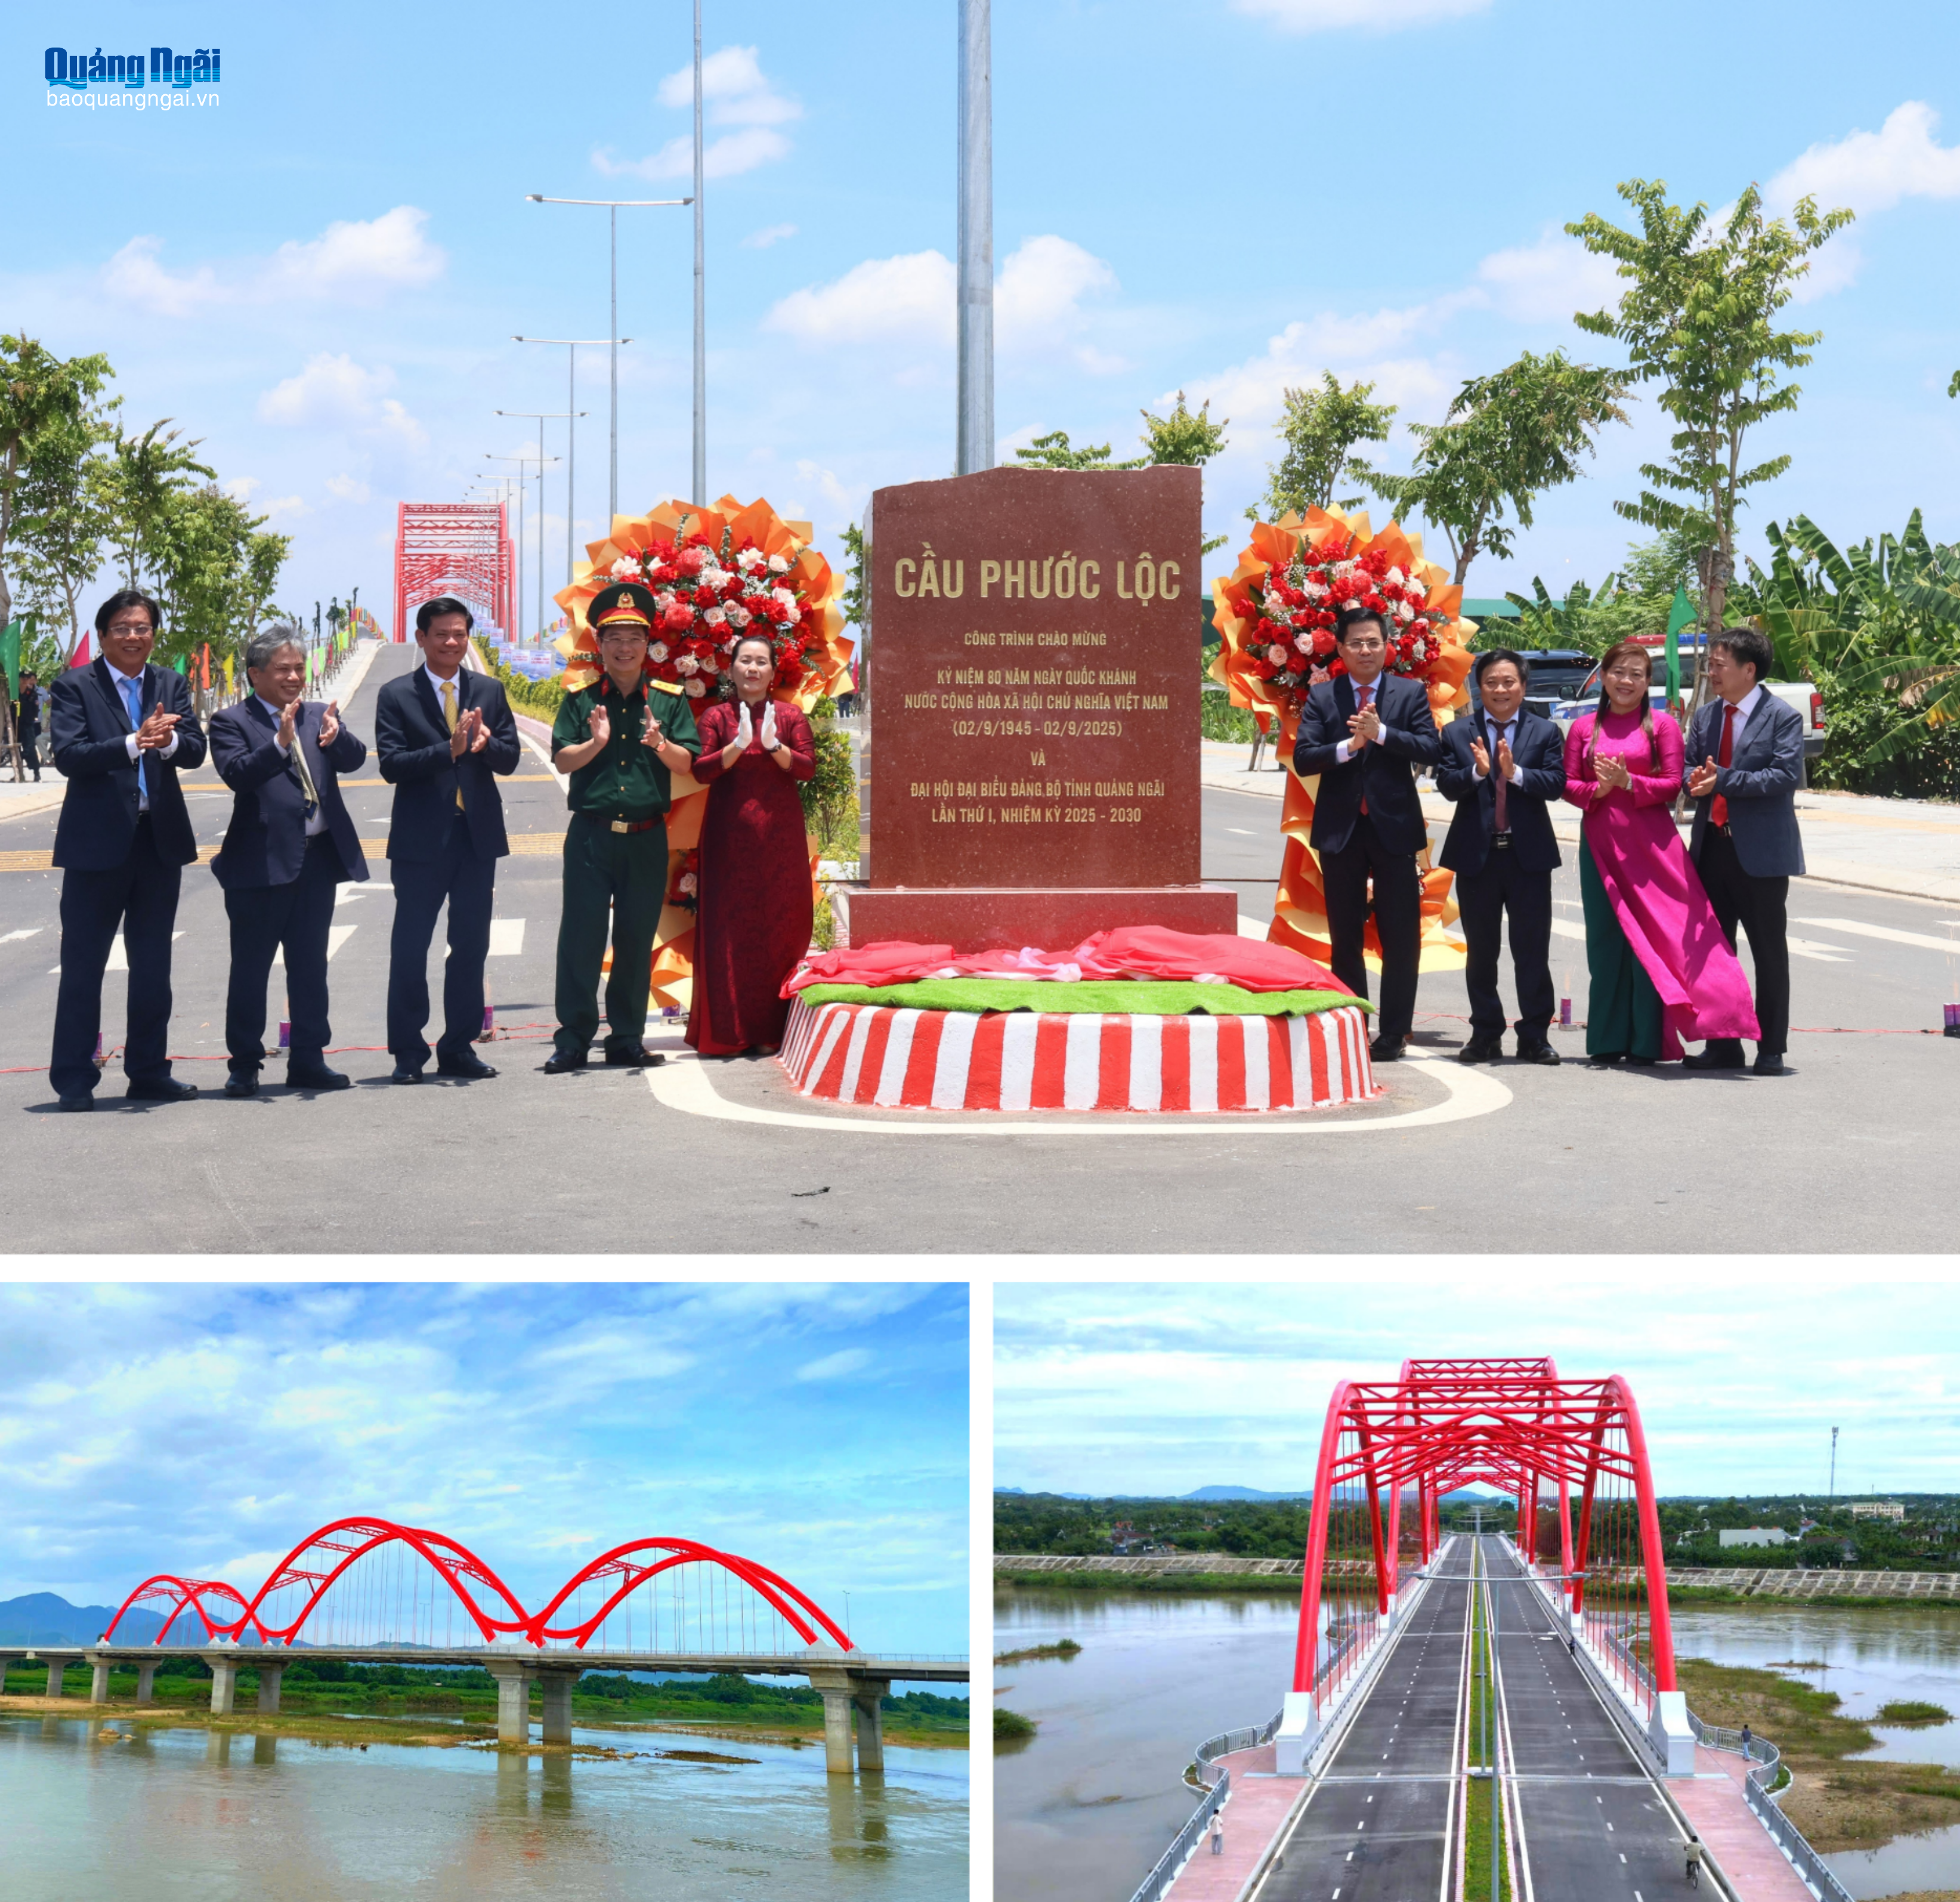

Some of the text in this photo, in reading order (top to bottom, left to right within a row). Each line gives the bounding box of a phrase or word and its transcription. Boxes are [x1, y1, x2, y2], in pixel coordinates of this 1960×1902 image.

[895, 542, 1180, 607] CẦU PHƯỚC LỘC
[964, 630, 1107, 646] CÔNG TRÌNH CHÀO MỪNG
[937, 665, 1137, 688] KỶ NIỆM 80 NĂM NGÀY QUỐC KHÁNH
[904, 690, 1168, 712] NƯỚC CỘNG HÒA XÃ HỘI CHỦ NGHĨA VIỆT NAM
[953, 720, 1032, 737] (02/9/1945
[1044, 720, 1123, 737] 02/9/2025)
[1031, 749, 1046, 766] VÀ
[910, 775, 1165, 800] ĐẠI HỘI ĐẠI BIỂU ĐẢNG BỘ TỈNH QUẢNG NGÃI
[932, 802, 956, 822] LẦN
[959, 805, 985, 822] THỨ
[988, 808, 997, 824] I,
[1001, 805, 1041, 825] NHIỆM
[1045, 805, 1062, 822] KỲ
[1064, 808, 1096, 822] 2025
[1109, 808, 1142, 822] 2030
